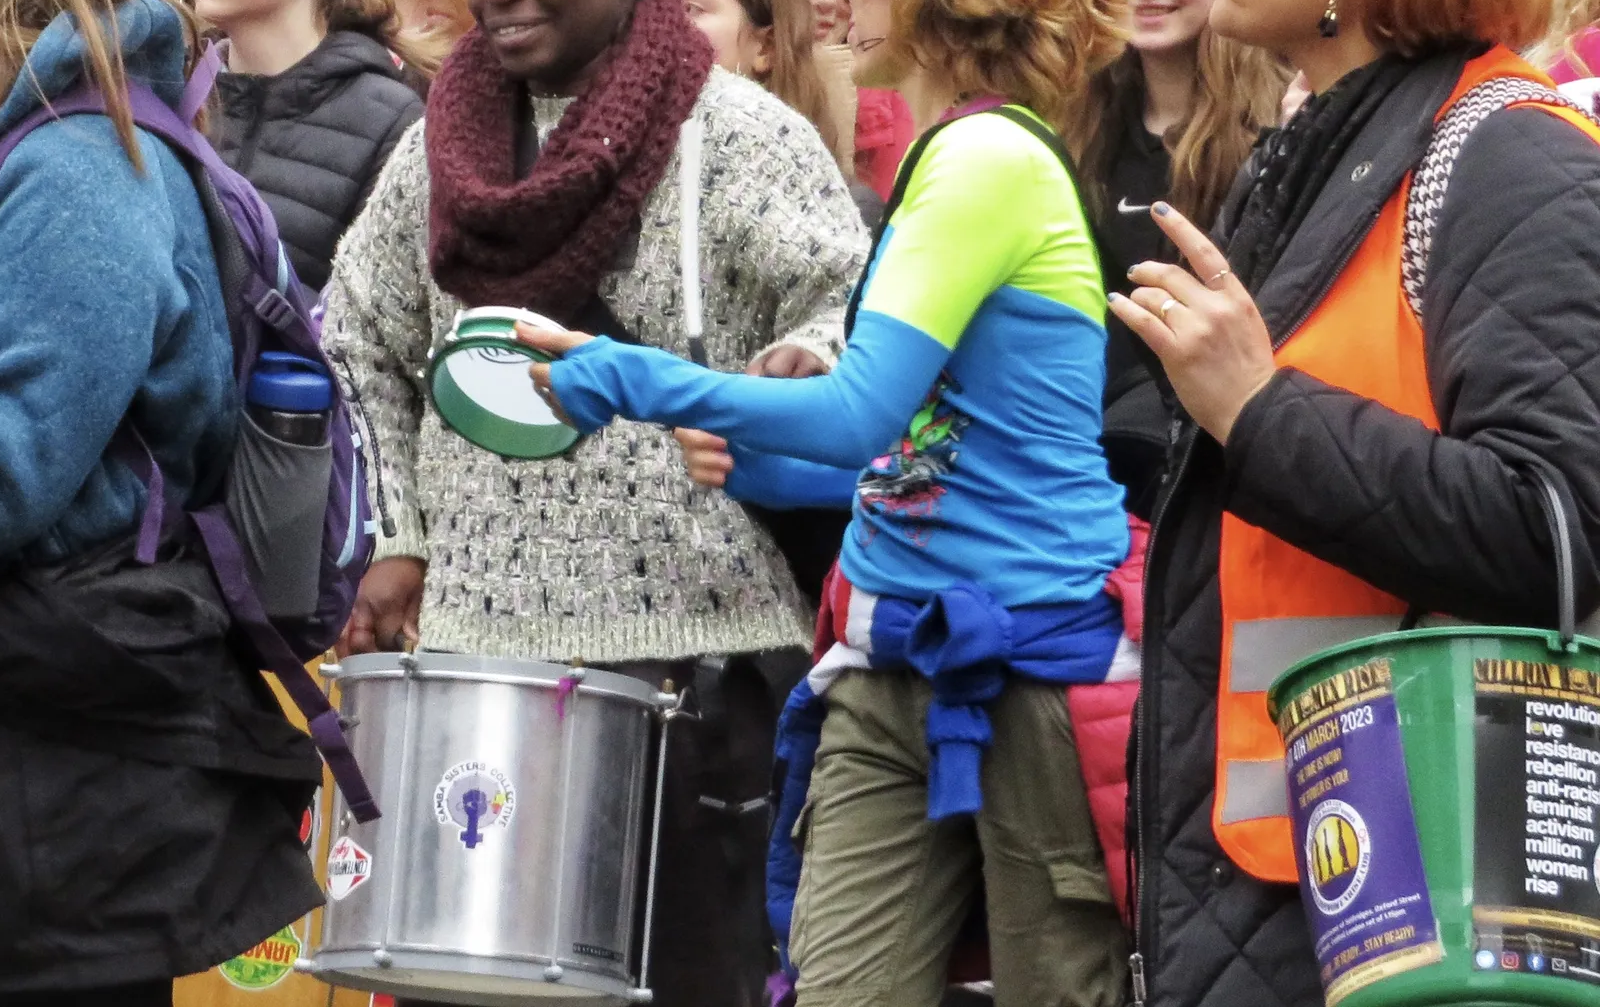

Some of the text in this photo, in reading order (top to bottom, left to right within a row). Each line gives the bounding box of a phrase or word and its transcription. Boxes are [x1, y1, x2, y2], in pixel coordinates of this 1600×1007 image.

[1305, 718, 1341, 751] MARCH
[1340, 705, 1374, 734] 2023
[445, 762, 487, 782] SISTERS
[1525, 758, 1597, 785] rebellion
[1526, 795, 1593, 823] feminist
[1526, 817, 1595, 843] activism
[1526, 837, 1582, 860] million
[1526, 858, 1588, 881] women
[1525, 875, 1559, 895] rise
